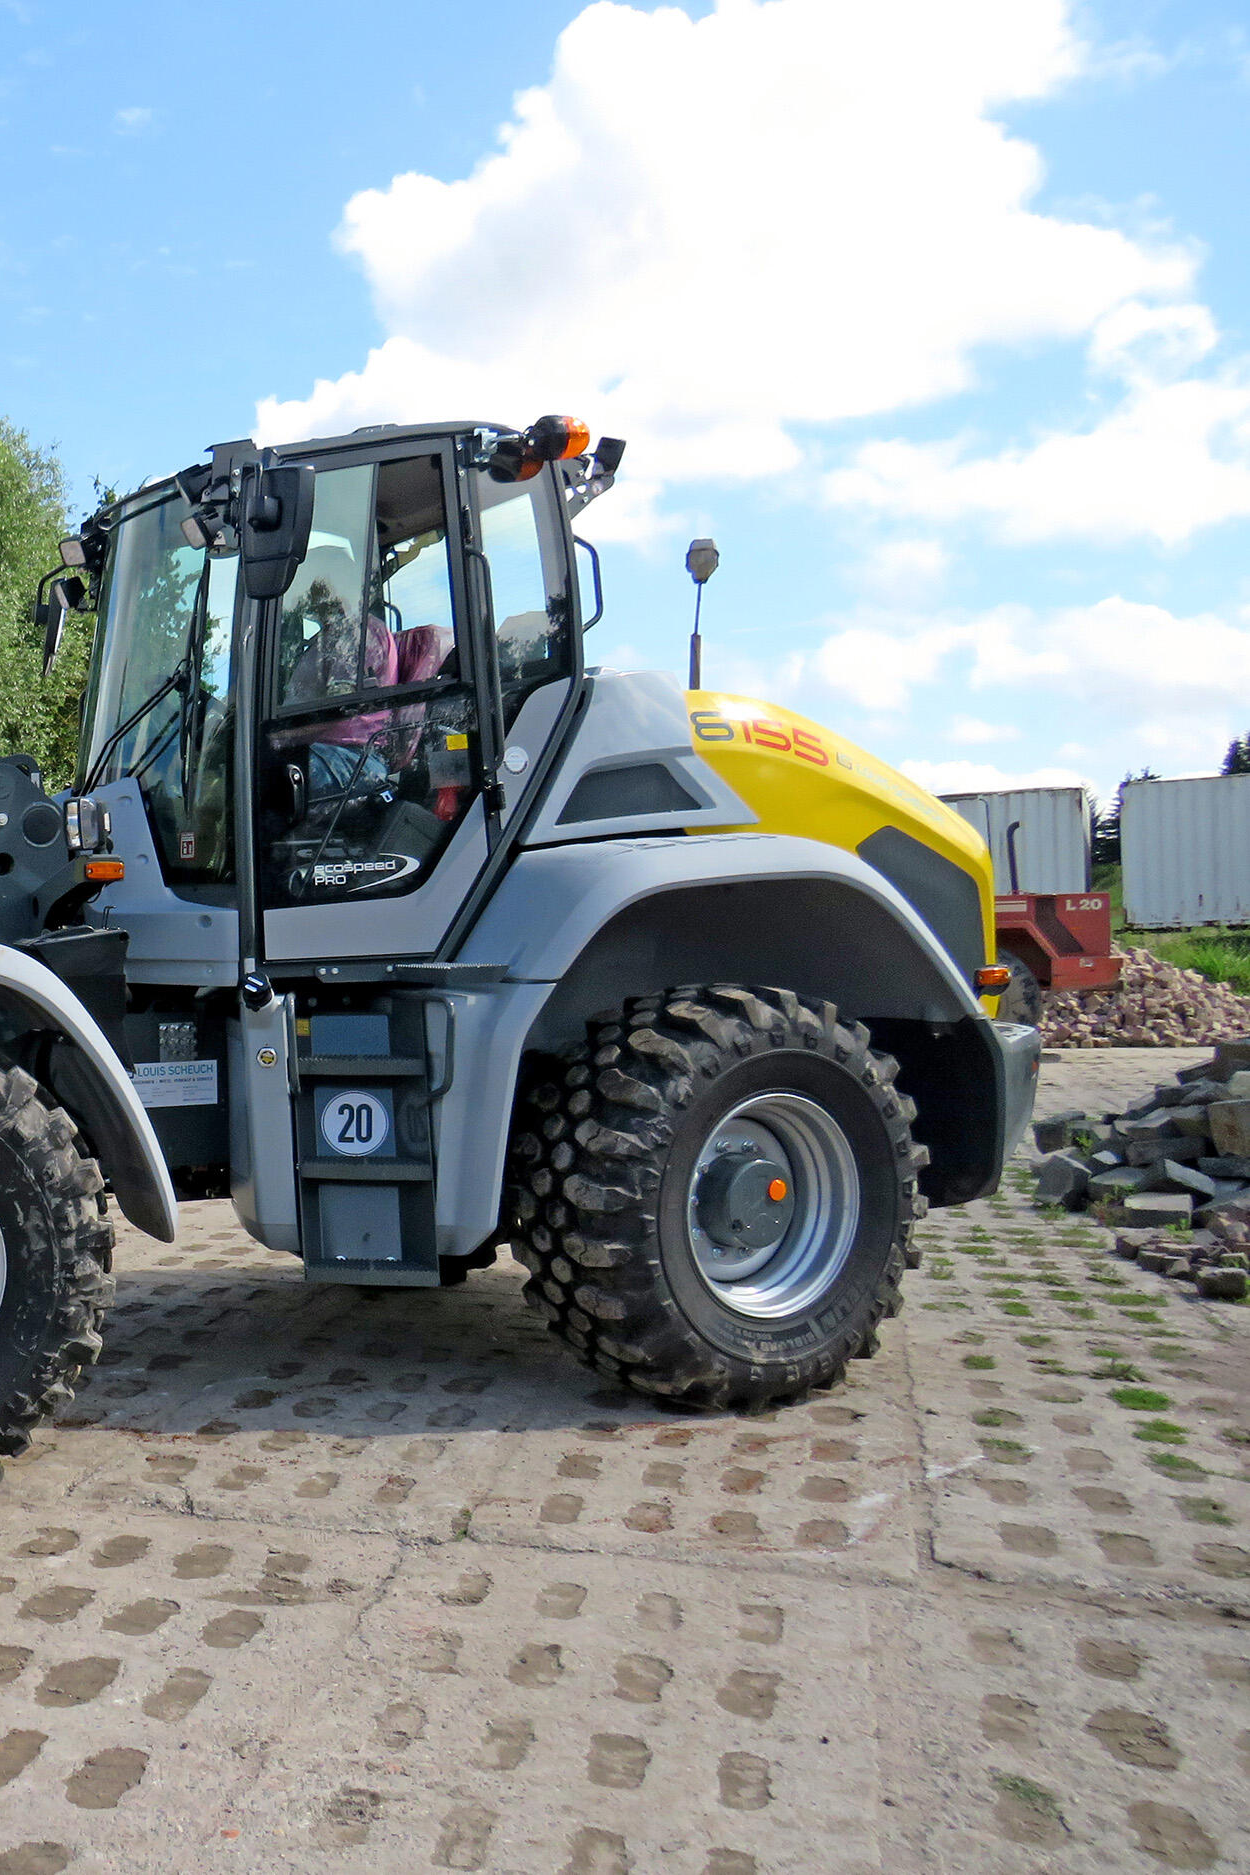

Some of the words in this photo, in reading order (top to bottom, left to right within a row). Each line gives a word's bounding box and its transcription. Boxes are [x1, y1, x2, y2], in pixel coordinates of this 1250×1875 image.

[690, 711, 829, 766] 8155
[314, 860, 396, 875] ecospeed
[315, 875, 347, 886] PRO
[1066, 899, 1077, 911] L
[1080, 898, 1102, 911] 20
[137, 1066, 166, 1078] LOUIS
[168, 1064, 214, 1076] SCHEUCH
[337, 1103, 373, 1143] 20
